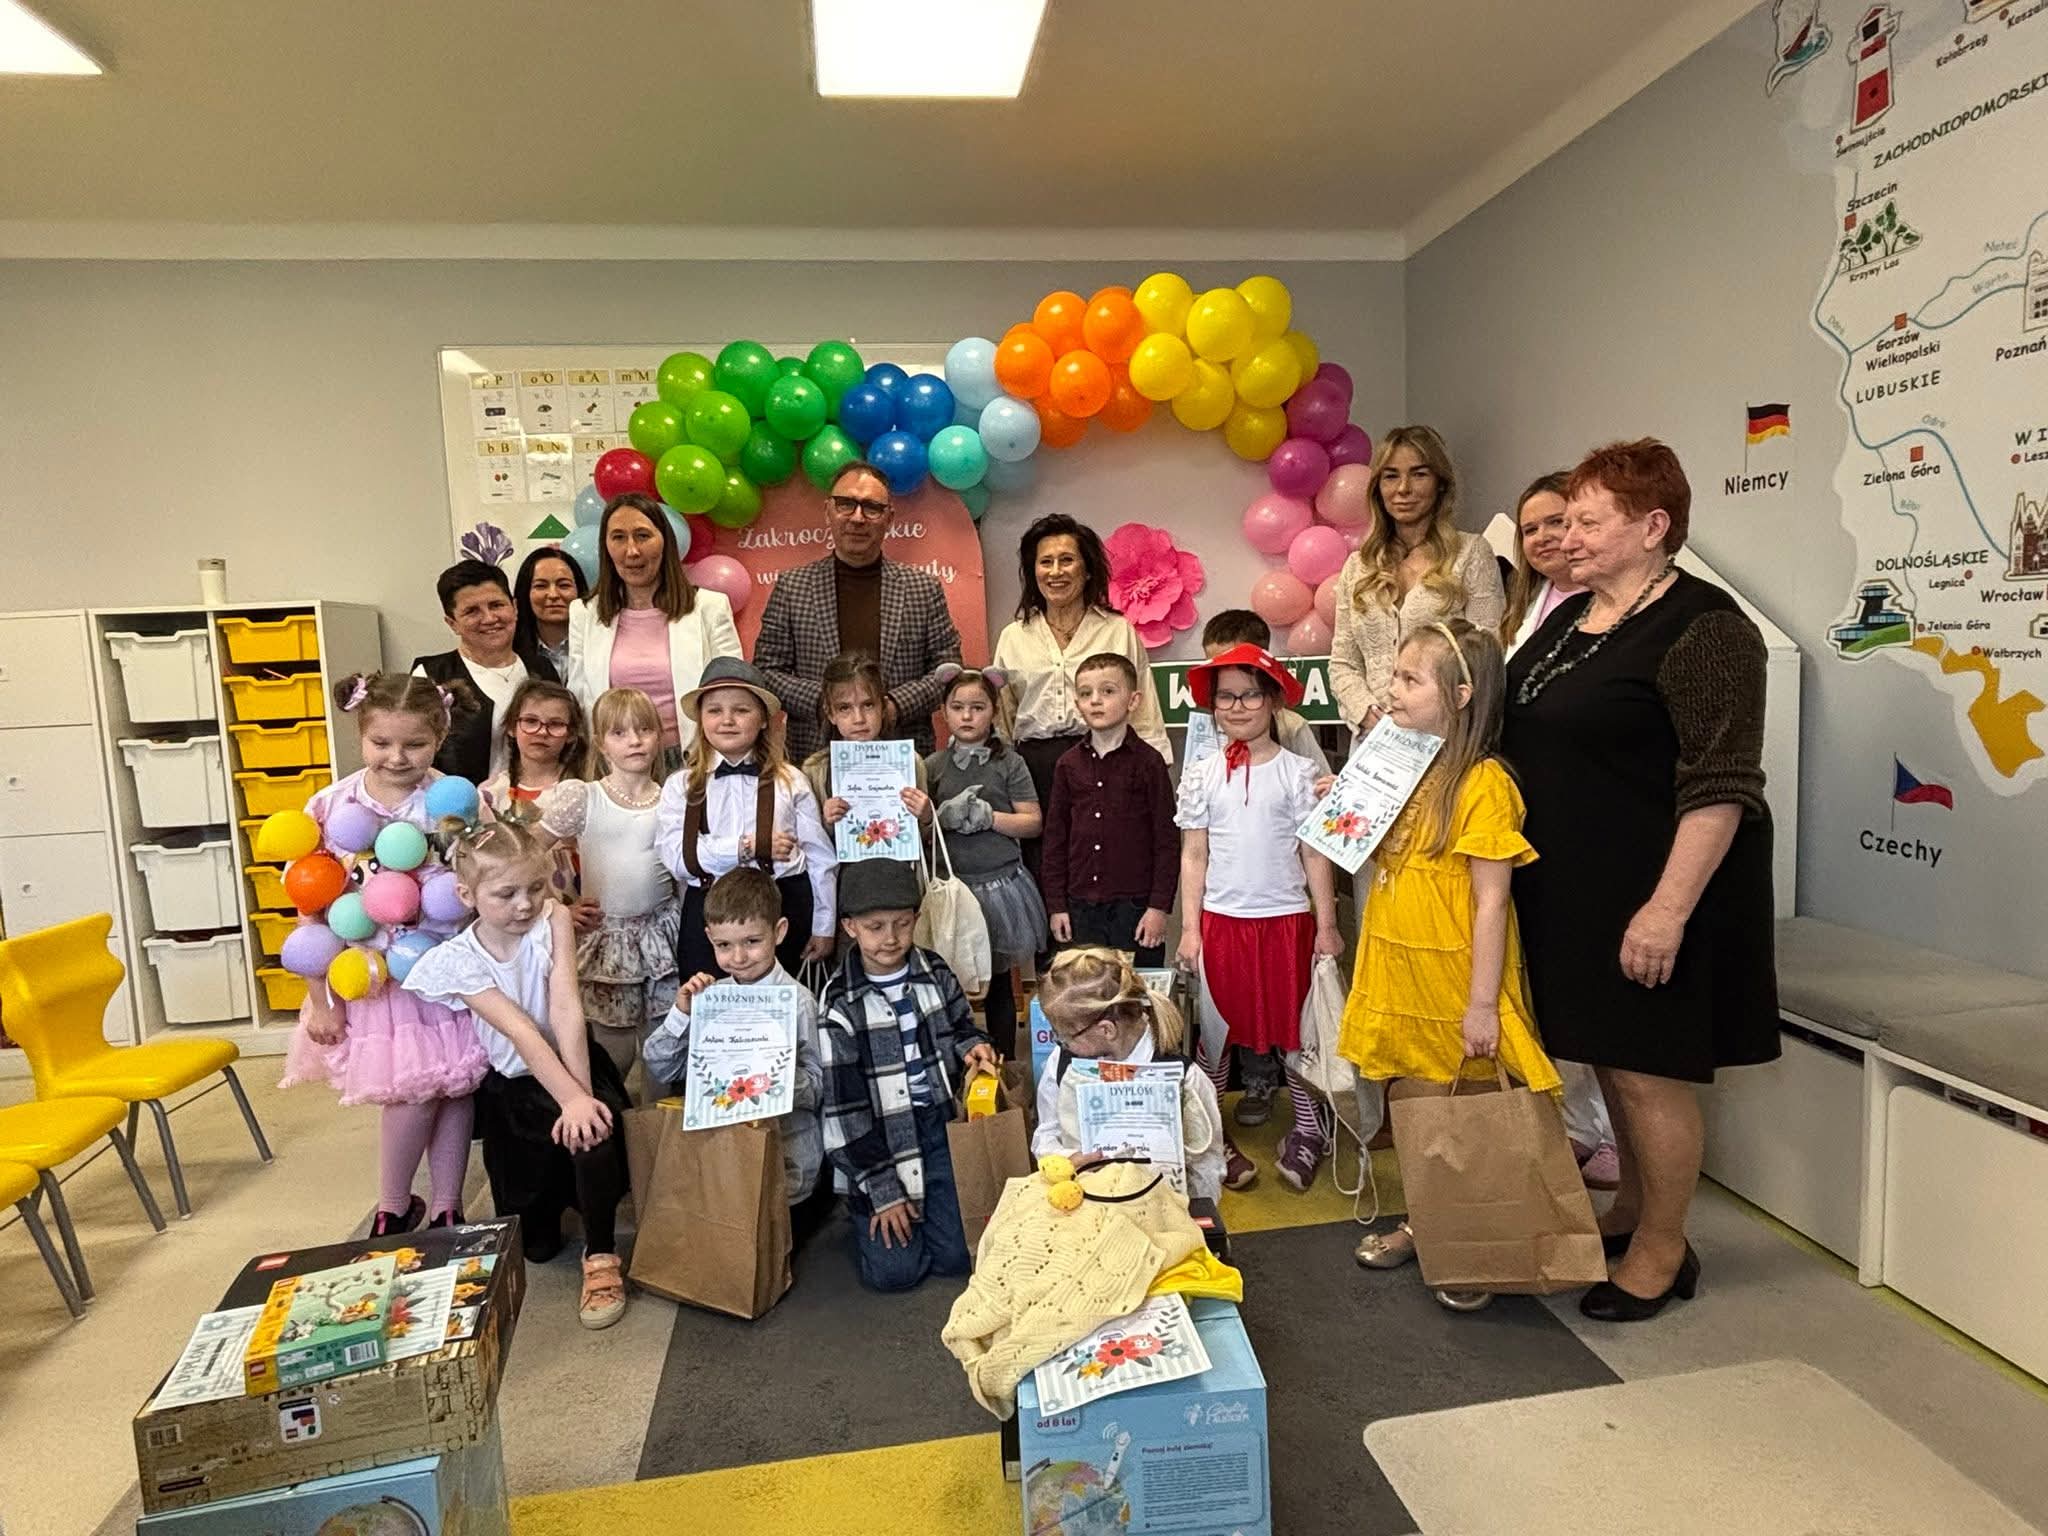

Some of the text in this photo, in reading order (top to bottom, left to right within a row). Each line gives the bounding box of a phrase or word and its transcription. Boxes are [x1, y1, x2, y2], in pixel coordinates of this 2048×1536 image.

[1847, 183, 1898, 213] Szczecin
[1876, 330, 1921, 353] Gorzów
[1995, 335, 2048, 361] Poznań
[1865, 341, 1941, 371] Wielkopolski
[1856, 370, 1941, 404] LUBUSKIE
[1725, 471, 1788, 496] Niemcy
[1863, 462, 1941, 486] Zielona Góra
[1876, 550, 1989, 571] DOLNOŚLĄSKIE
[1929, 578, 1965, 590] Legnica
[1981, 588, 2044, 603] Wrocław
[1927, 620, 1990, 631] Jelenia Góra
[1983, 647, 2042, 660] Wałbrzych
[1860, 830, 1942, 868] Czechy
[1110, 1086, 1153, 1097] DYPLOM
